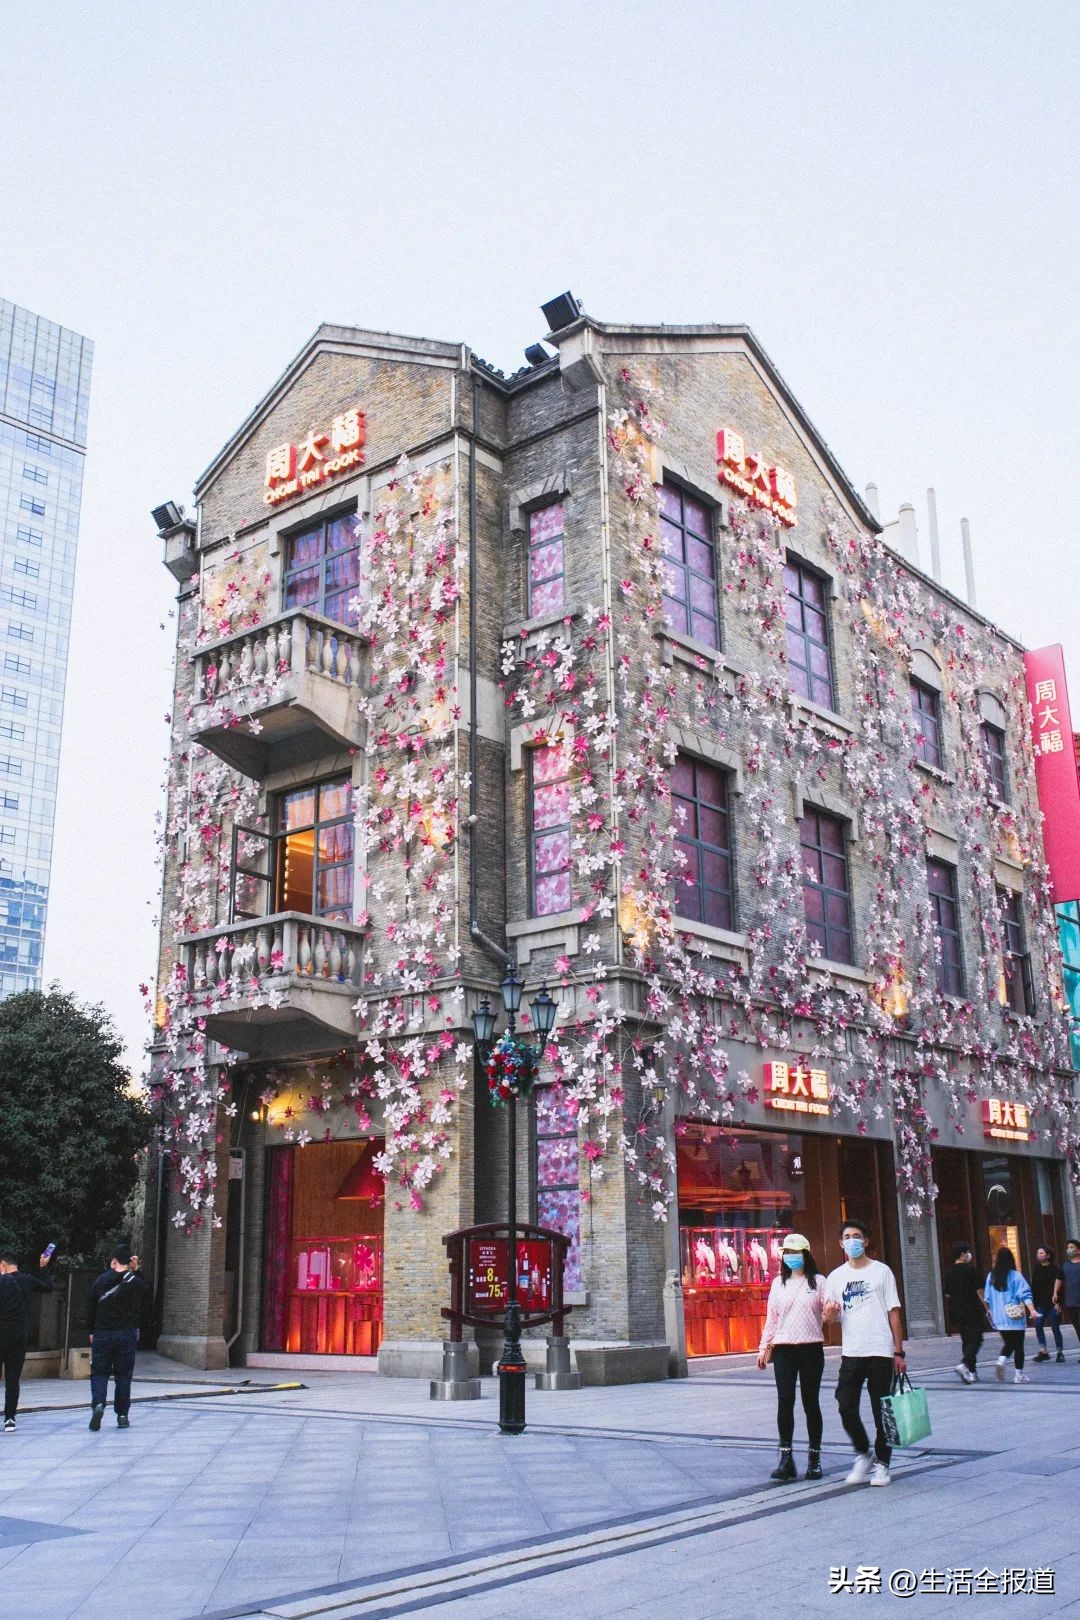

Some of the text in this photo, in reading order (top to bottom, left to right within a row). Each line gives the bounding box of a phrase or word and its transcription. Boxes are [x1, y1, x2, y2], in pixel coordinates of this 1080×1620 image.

[263, 448, 361, 504] CHOW TAI FOOK
[264, 408, 364, 487] 周大福
[722, 427, 798, 508] 周大福
[1035, 678, 1064, 754] 周大福
[771, 1060, 828, 1099] 周大福
[988, 1098, 1028, 1128] 周大福
